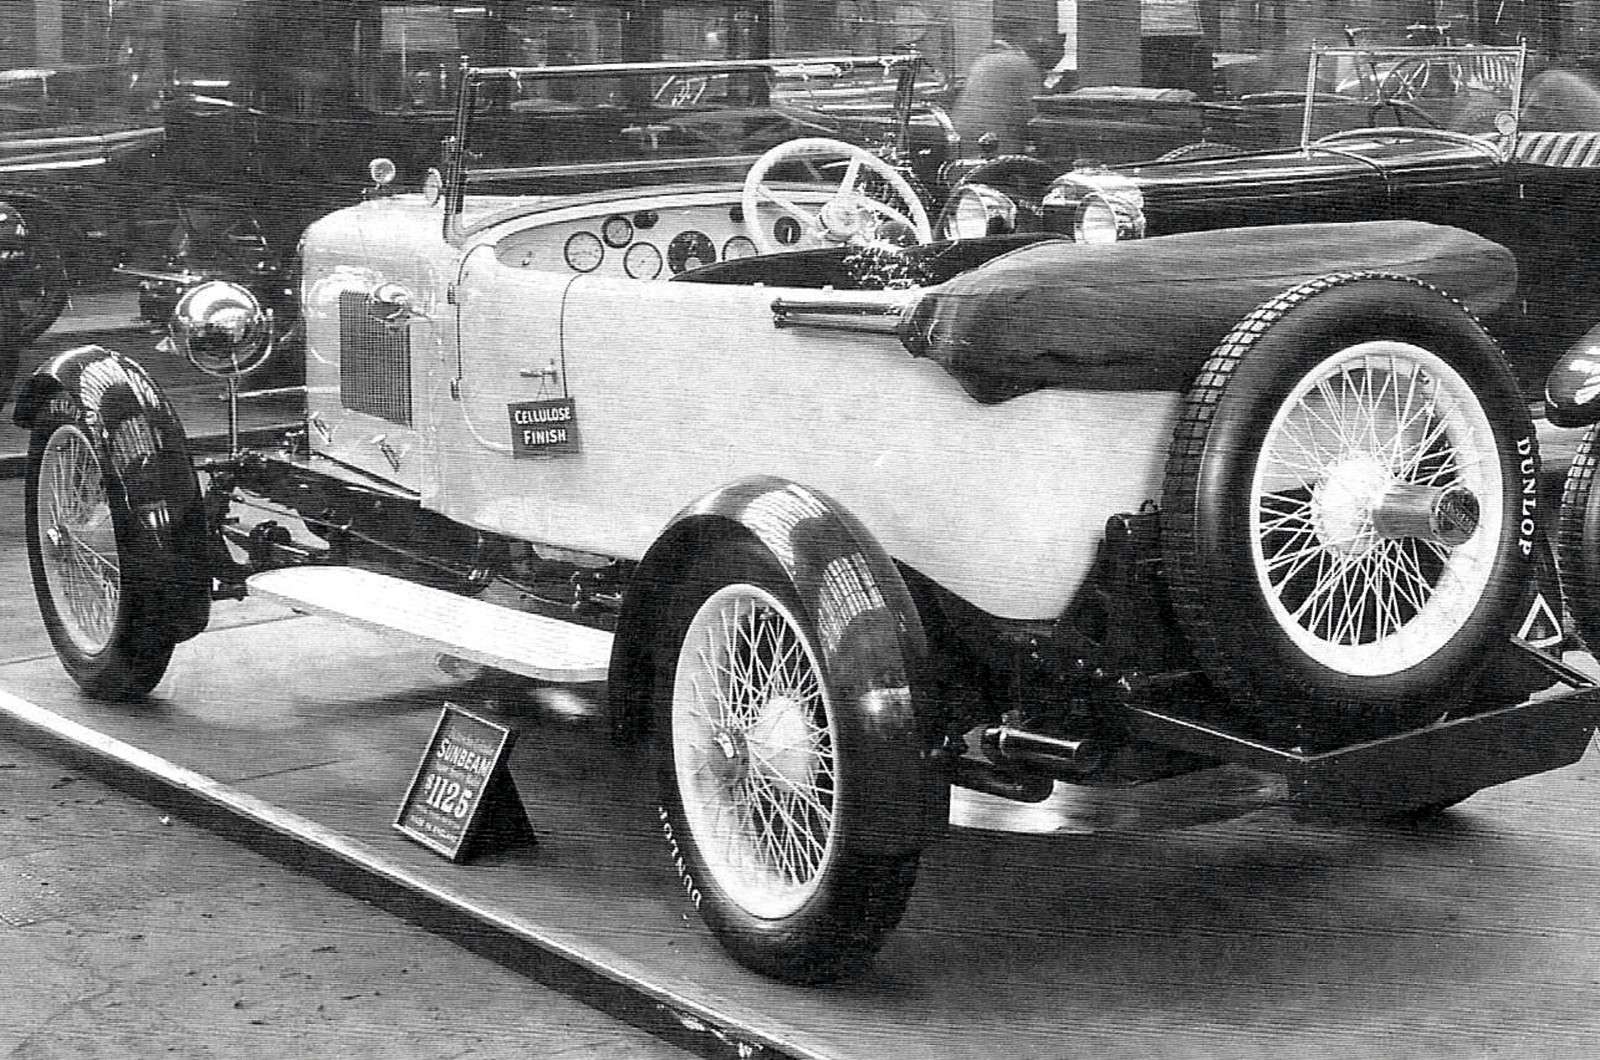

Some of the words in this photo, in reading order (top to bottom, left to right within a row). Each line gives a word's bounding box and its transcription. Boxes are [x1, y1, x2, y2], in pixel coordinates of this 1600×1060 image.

[514, 407, 571, 425] CELLULOSE
[523, 429, 567, 445] FINISH
[1516, 437, 1536, 556] DUNLOP
[436, 737, 492, 777] SUNBEAM
[424, 773, 473, 818] $1125
